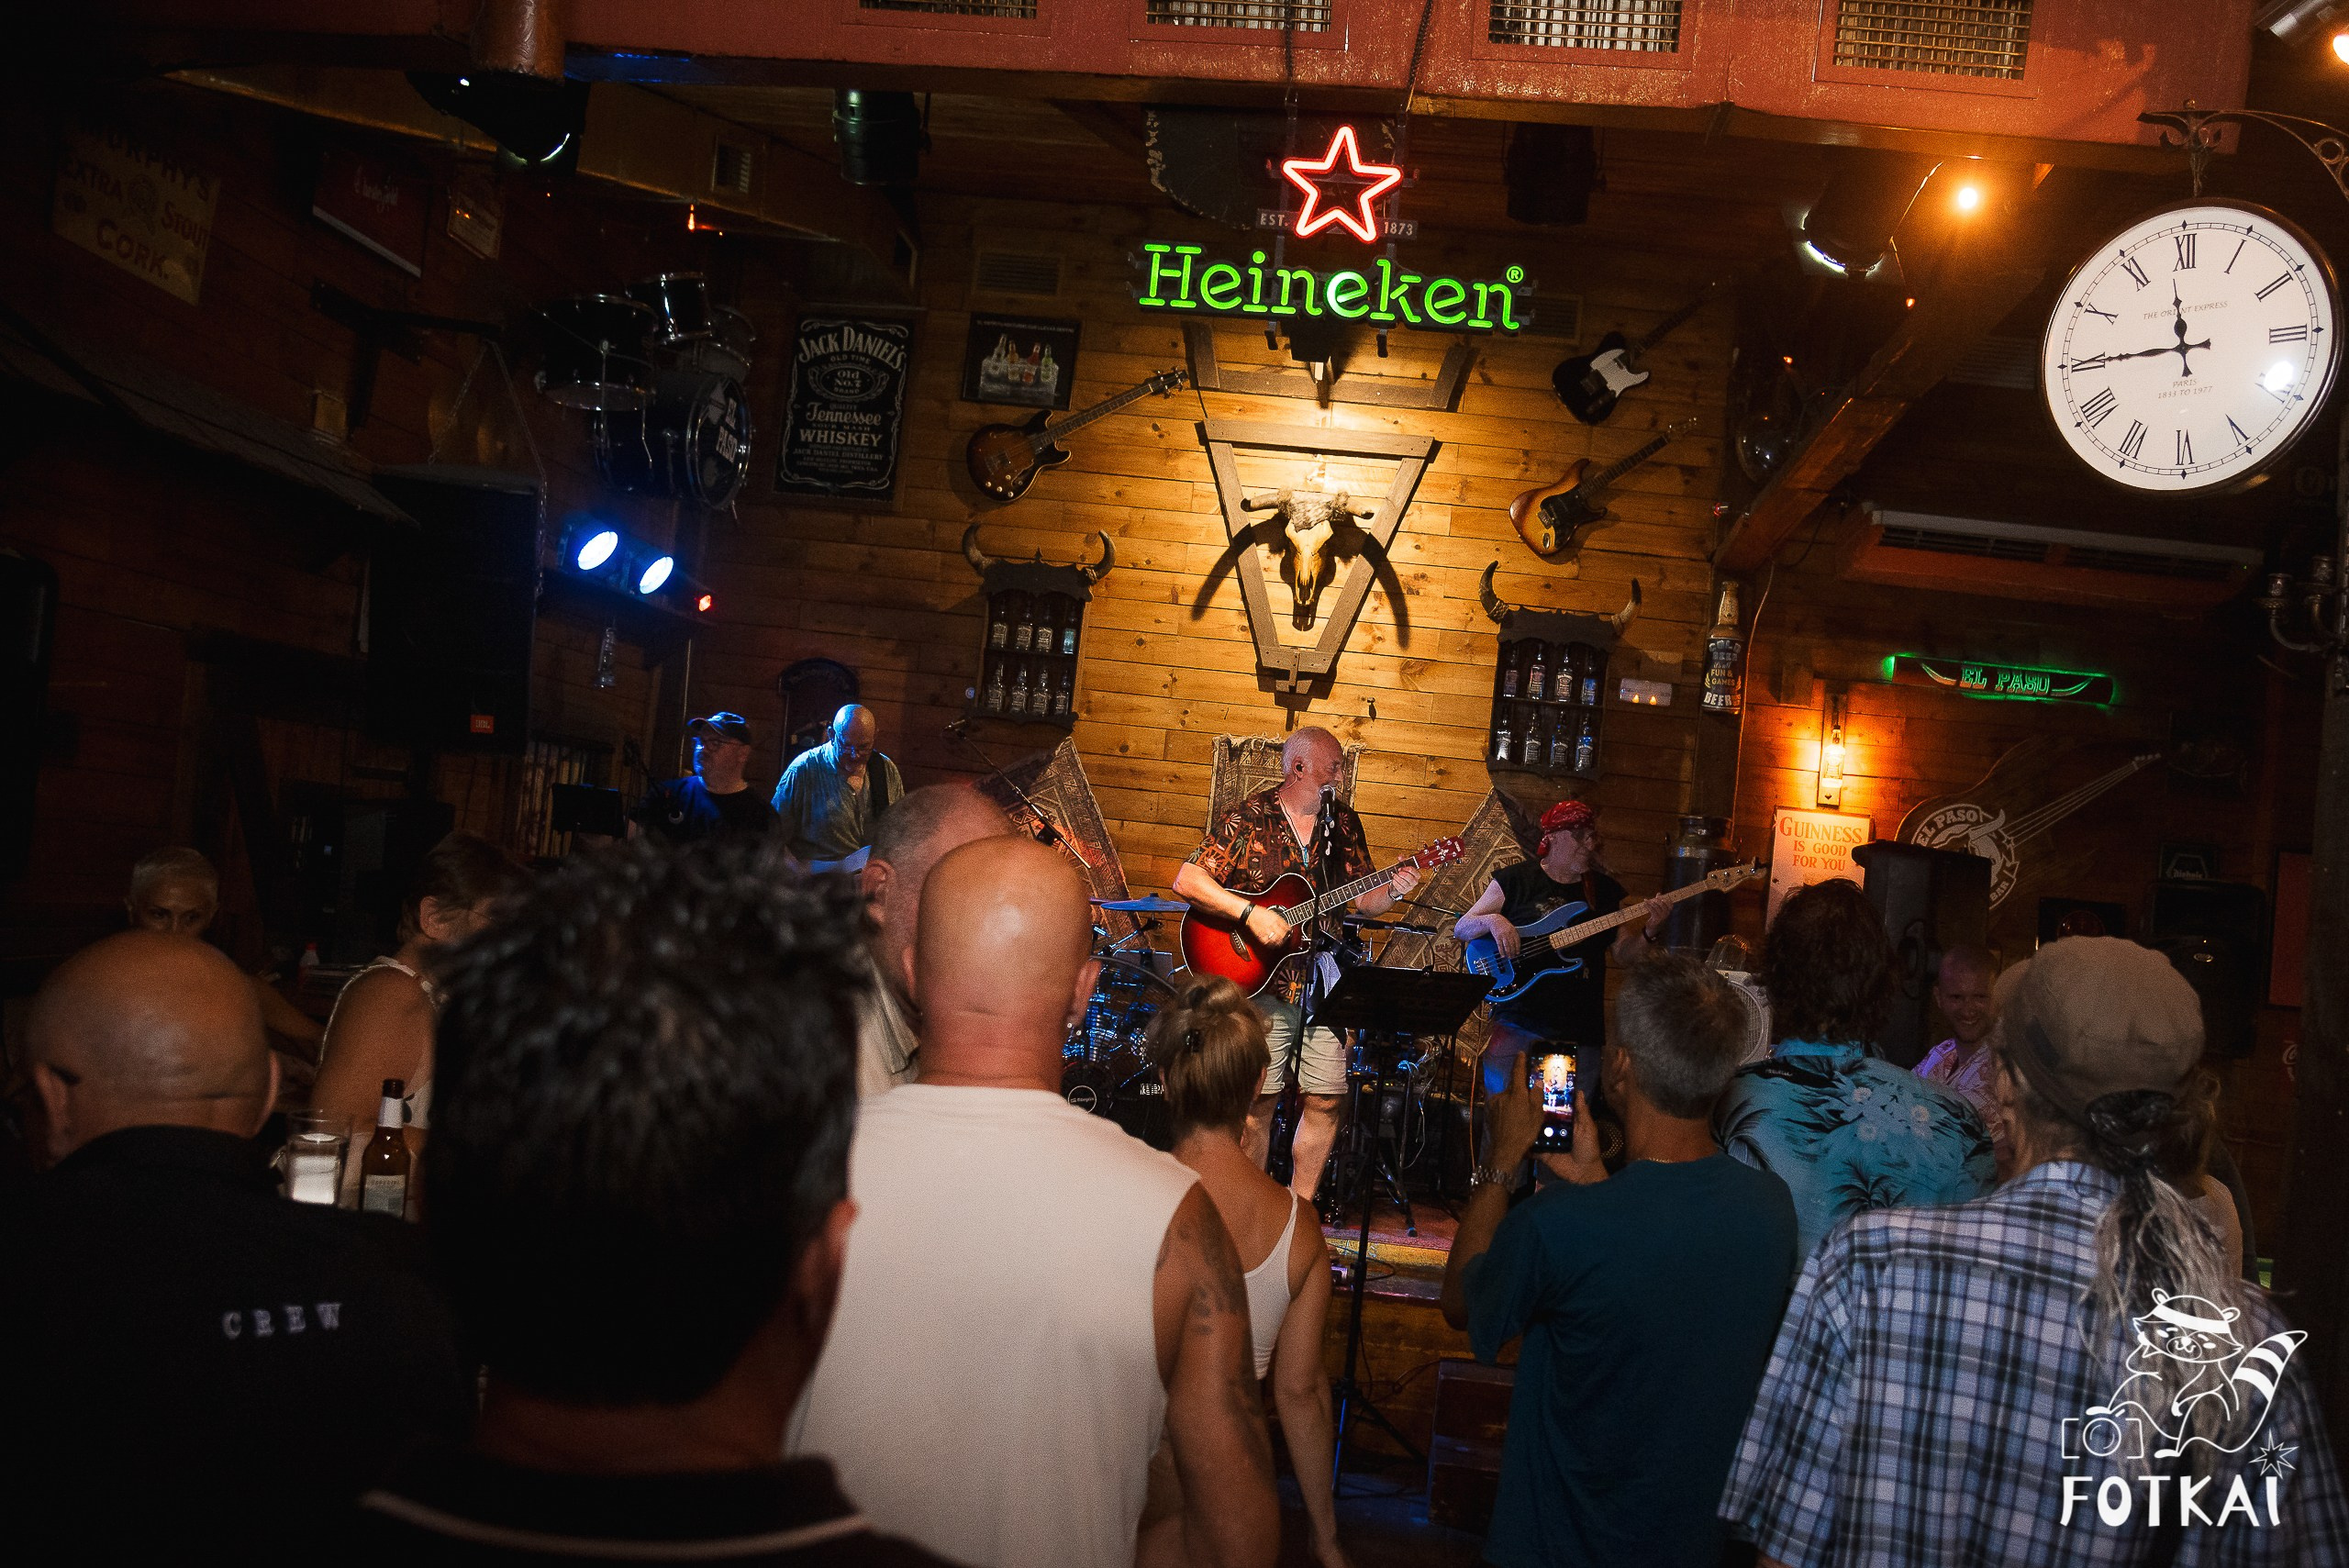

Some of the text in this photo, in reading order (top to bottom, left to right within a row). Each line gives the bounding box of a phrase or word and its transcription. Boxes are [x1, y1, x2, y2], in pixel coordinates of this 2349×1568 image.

[161, 200, 208, 250] STOUT
[1259, 213, 1414, 237] EST. 1873
[2173, 233, 2197, 272] XII
[2121, 256, 2151, 292] XI
[2254, 271, 2293, 302] II
[2084, 302, 2119, 325] X
[2161, 306, 2192, 317] ORINT
[2194, 301, 2229, 313] EXPRESS
[2269, 323, 2307, 345] III
[798, 325, 907, 371] JACK DANIEL'S
[830, 354, 872, 365] OLD TIME
[837, 369, 860, 380] Old
[2172, 379, 2198, 388] PARIS
[833, 386, 860, 395] BRAND
[2180, 388, 2191, 396] TO
[2194, 386, 2213, 395] 1977
[806, 401, 882, 426] Tennessee
[799, 428, 883, 452] WHISKEY
[2225, 413, 2251, 447] V
[716, 425, 738, 463] PASO
[2176, 428, 2196, 466] VI
[1710, 669, 1726, 677] FUN
[1711, 677, 1736, 686] GAMES
[1959, 666, 2051, 695] EL PASO
[1703, 691, 1732, 706] BEER
[1780, 816, 1863, 844] GUINNESS
[1916, 809, 1979, 847] EL PASO
[1794, 840, 1847, 857] IS GOOD
[1793, 854, 1846, 872] FOR YOU
[221, 1301, 342, 1340] CREW
